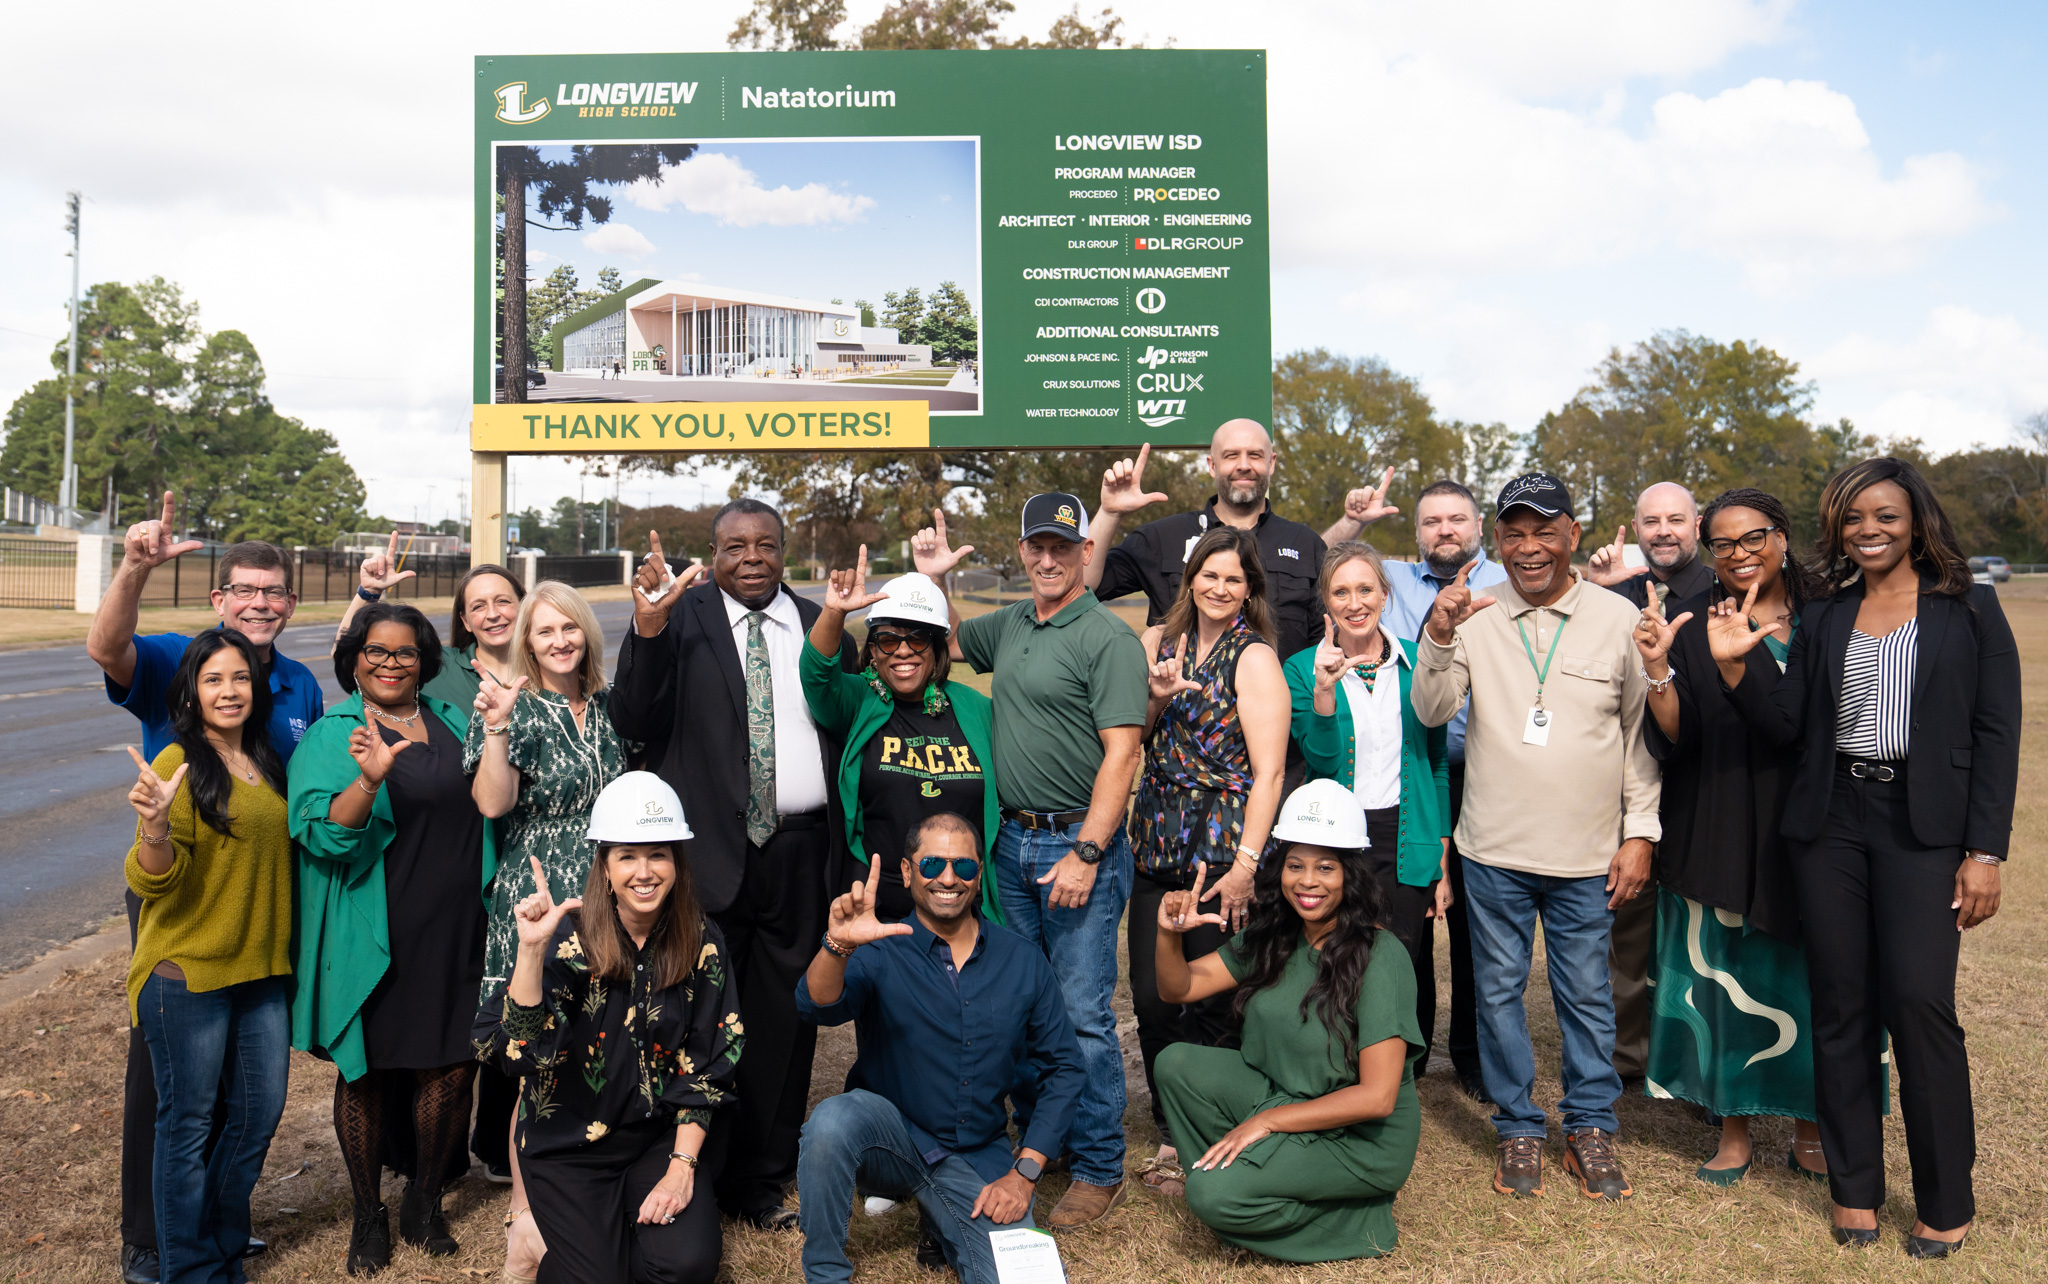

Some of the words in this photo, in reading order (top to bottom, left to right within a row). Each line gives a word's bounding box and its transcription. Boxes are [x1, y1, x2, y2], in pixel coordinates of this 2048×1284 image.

[556, 82, 698, 105] LONGVIEW
[741, 84, 896, 108] Natatorium
[578, 106, 615, 118] HIGH
[620, 105, 677, 118] SCHOOL
[1055, 134, 1164, 150] LONGVIEW
[1168, 134, 1202, 150] ISD
[1054, 167, 1123, 180] PROGRAM
[1127, 166, 1196, 179] MANAGER
[1069, 189, 1118, 199] PROCEDEO
[1133, 187, 1221, 203] PROCEDEO
[998, 214, 1076, 228] ARCHITECT
[1088, 214, 1150, 227] INTERIOR
[1163, 213, 1252, 226] ENGINEERING
[1067, 239, 1086, 249] DLR
[1086, 239, 1119, 249] GROUP
[1022, 267, 1131, 281] CONSTRUCTION
[1132, 266, 1231, 279] MANAGEMENT
[1034, 297, 1051, 307] CDI
[1051, 297, 1119, 307] CONTRACTORS
[1035, 325, 1118, 339] ADDITIONAL
[1120, 325, 1220, 338] CONSULTANTS
[632, 351, 652, 359] LOBO
[1023, 353, 1068, 363] JOHNSON
[1069, 353, 1077, 362] &
[1077, 353, 1101, 363] PACE
[1101, 353, 1120, 362] INC.
[1042, 380, 1068, 389] CRUX
[1069, 379, 1121, 389] SOLUTIONS
[1136, 373, 1205, 393] CRUX
[1025, 408, 1057, 418] WATER
[1058, 407, 1120, 418] TECHNOLOGY
[1137, 399, 1187, 415] WTI
[522, 414, 641, 440] THANK
[651, 413, 735, 442] YOU,
[746, 411, 891, 438] VOTERS!
[1278, 548, 1299, 560] LOBOS
[900, 602, 933, 612] LONGVIEW
[927, 736, 951, 745] THE
[636, 817, 673, 825] LONGVIEW
[999, 1242, 1050, 1252] Groundbreaking
